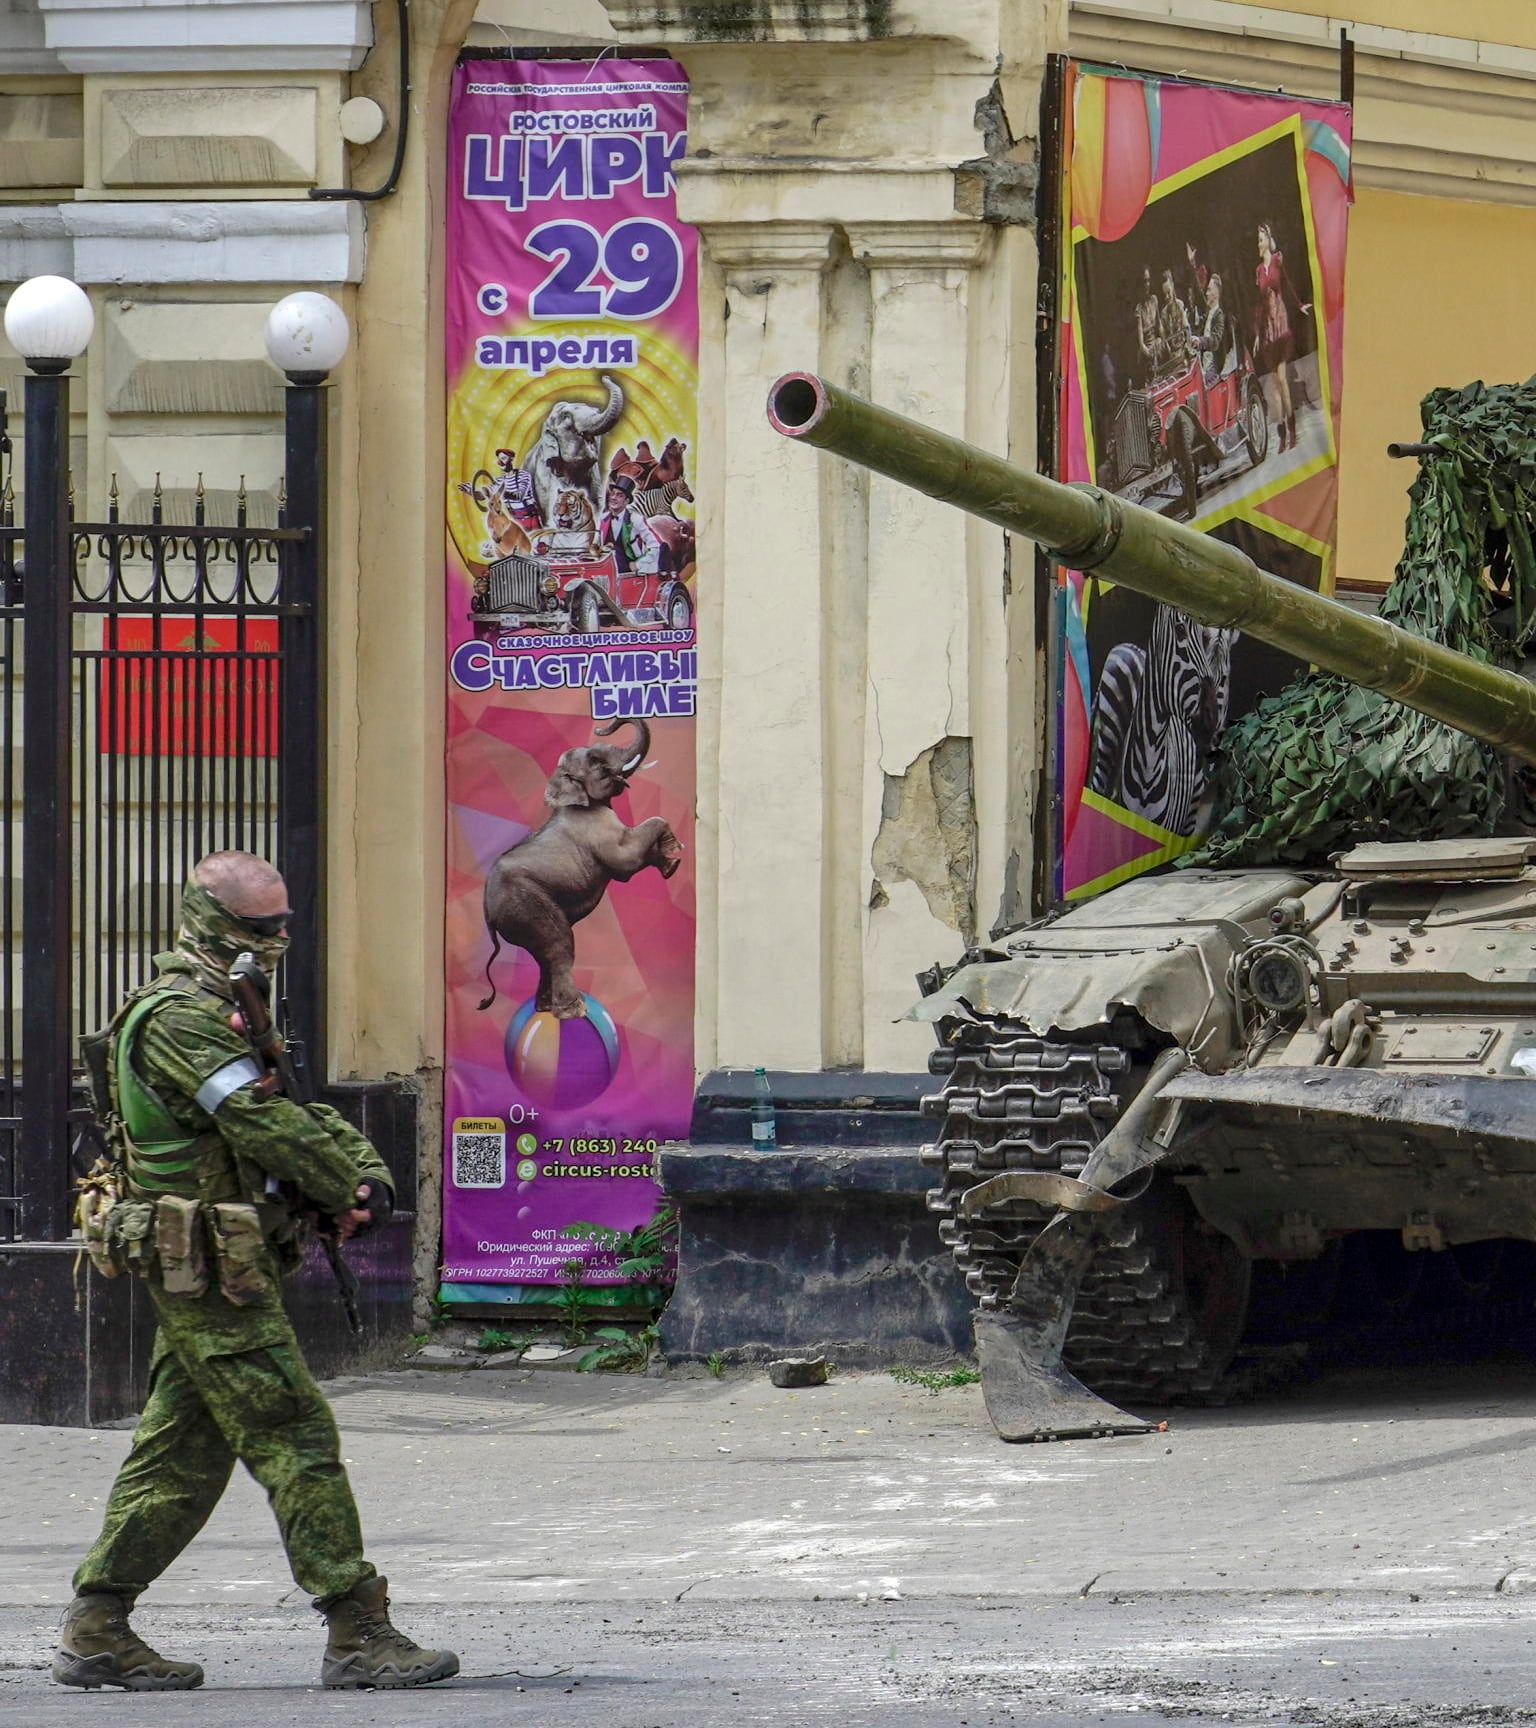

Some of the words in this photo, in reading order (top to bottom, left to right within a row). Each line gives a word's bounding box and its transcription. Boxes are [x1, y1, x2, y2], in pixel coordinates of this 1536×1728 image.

[605, 83, 652, 93] ЦИРКОВАЯ
[511, 107, 654, 132] РОСТОВСКИЙ
[527, 221, 680, 317] 29
[478, 338, 635, 374] апреля
[497, 635, 581, 650] СКАЗОЧНОЕ
[582, 632, 658, 648] ЦИРКОВОЕ
[659, 629, 694, 643] ШОУ
[593, 685, 698, 718] БИЛЕ
[509, 1103, 540, 1125] 0+
[460, 1121, 498, 1131] БИЛЕТЫ
[542, 1139, 564, 1153] +7
[569, 1138, 617, 1156] (863)
[531, 1229, 556, 1240] ФКП
[477, 1240, 553, 1254] Юридический
[555, 1243, 591, 1254] адрес:
[510, 1256, 526, 1267] ул.
[475, 1268, 549, 1278] 1027739272527
